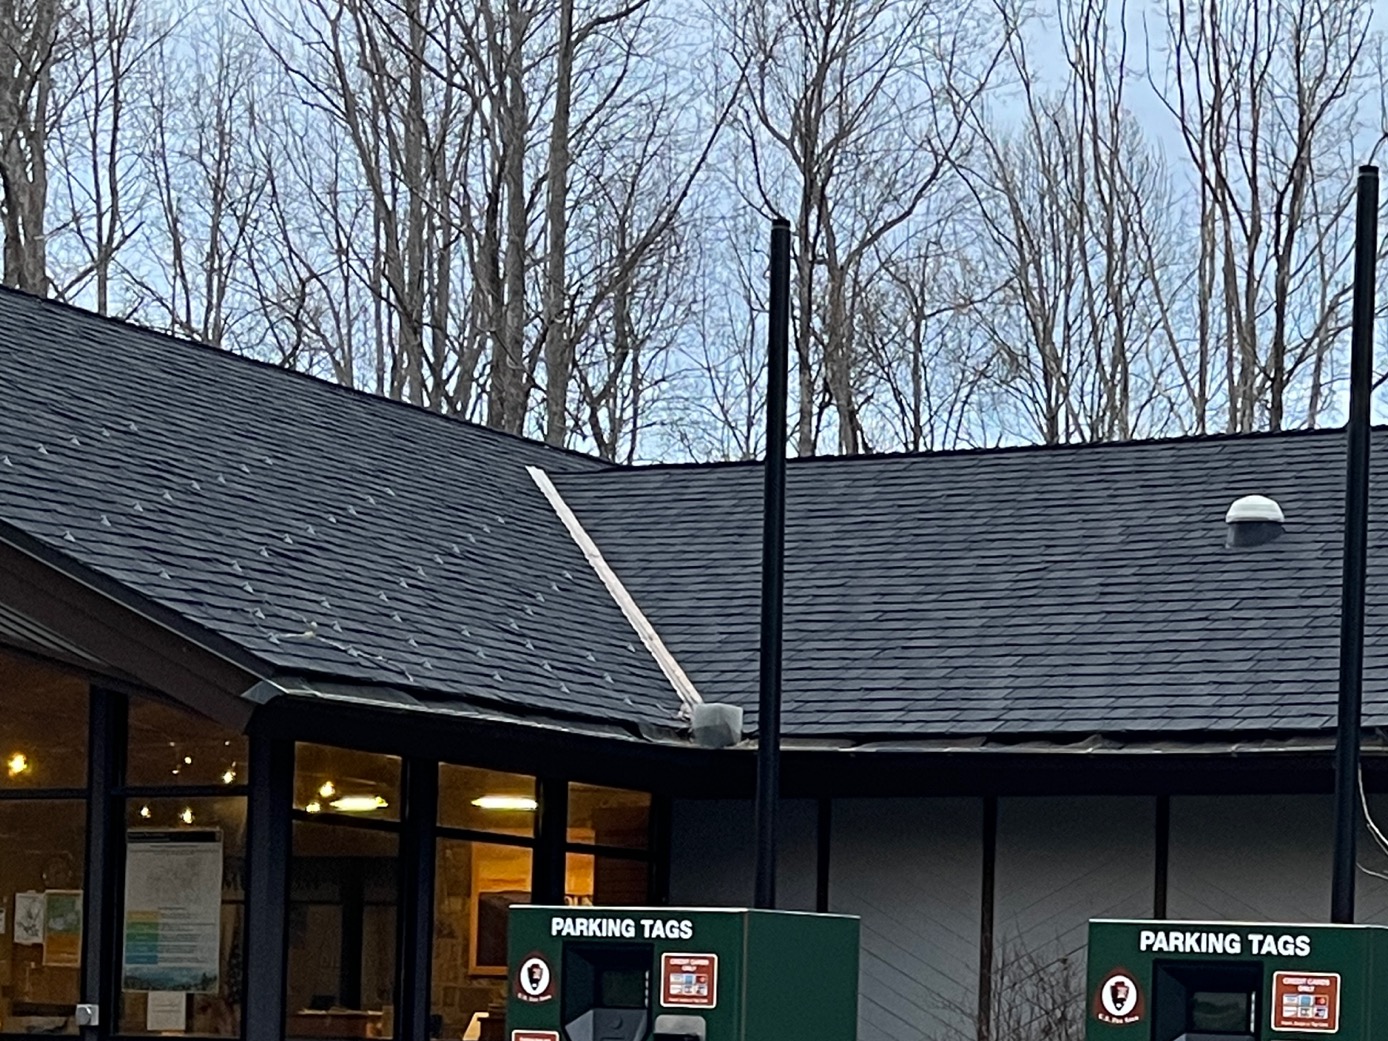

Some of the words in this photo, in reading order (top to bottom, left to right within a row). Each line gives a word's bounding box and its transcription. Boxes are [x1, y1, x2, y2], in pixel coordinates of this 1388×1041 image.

[551, 917, 636, 938] PARKING
[640, 919, 693, 939] TAGS
[1140, 931, 1241, 954] PARKING
[1248, 934, 1311, 956] TAGS
